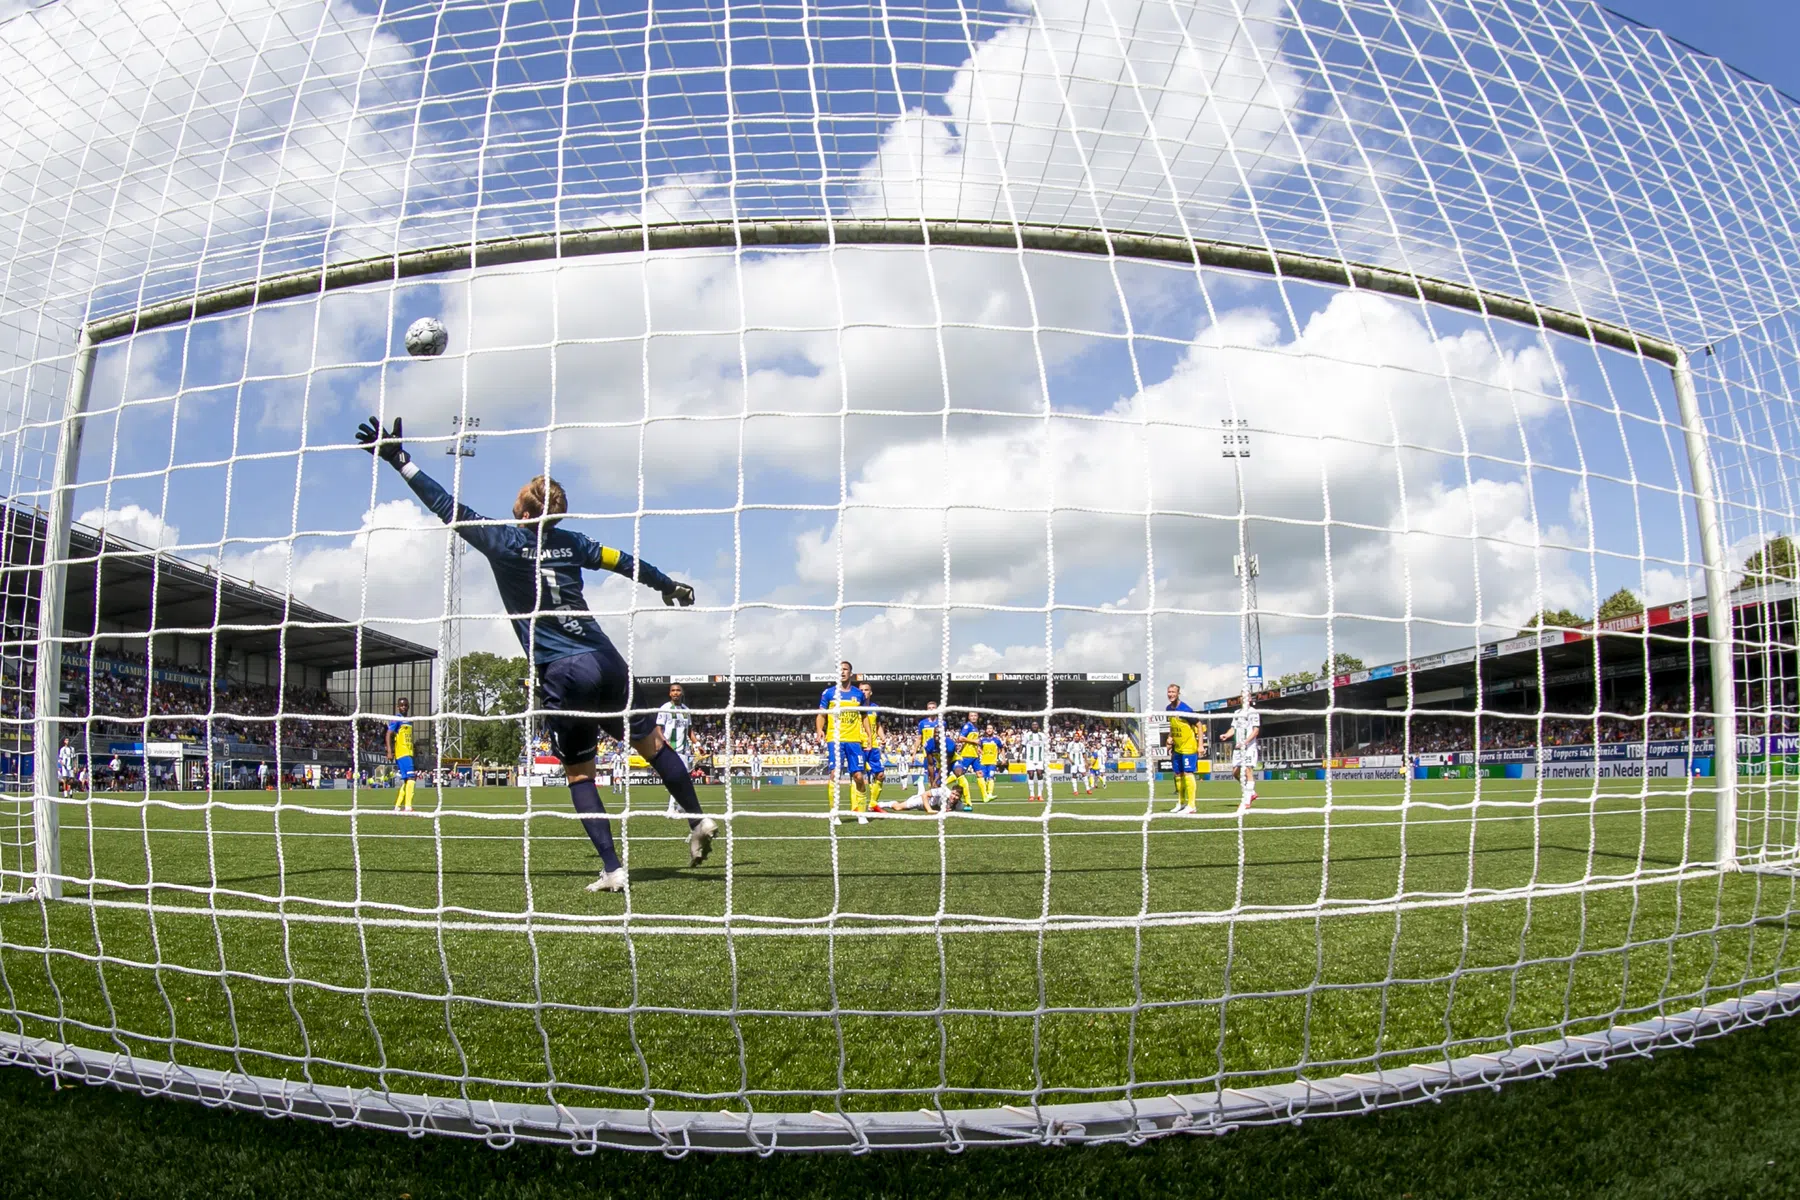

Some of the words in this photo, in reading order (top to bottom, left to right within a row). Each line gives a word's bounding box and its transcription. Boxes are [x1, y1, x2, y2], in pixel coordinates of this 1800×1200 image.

[1528, 634, 1555, 648] slaman
[1649, 743, 1679, 756] toppers
[1552, 763, 1590, 777] netwerk
